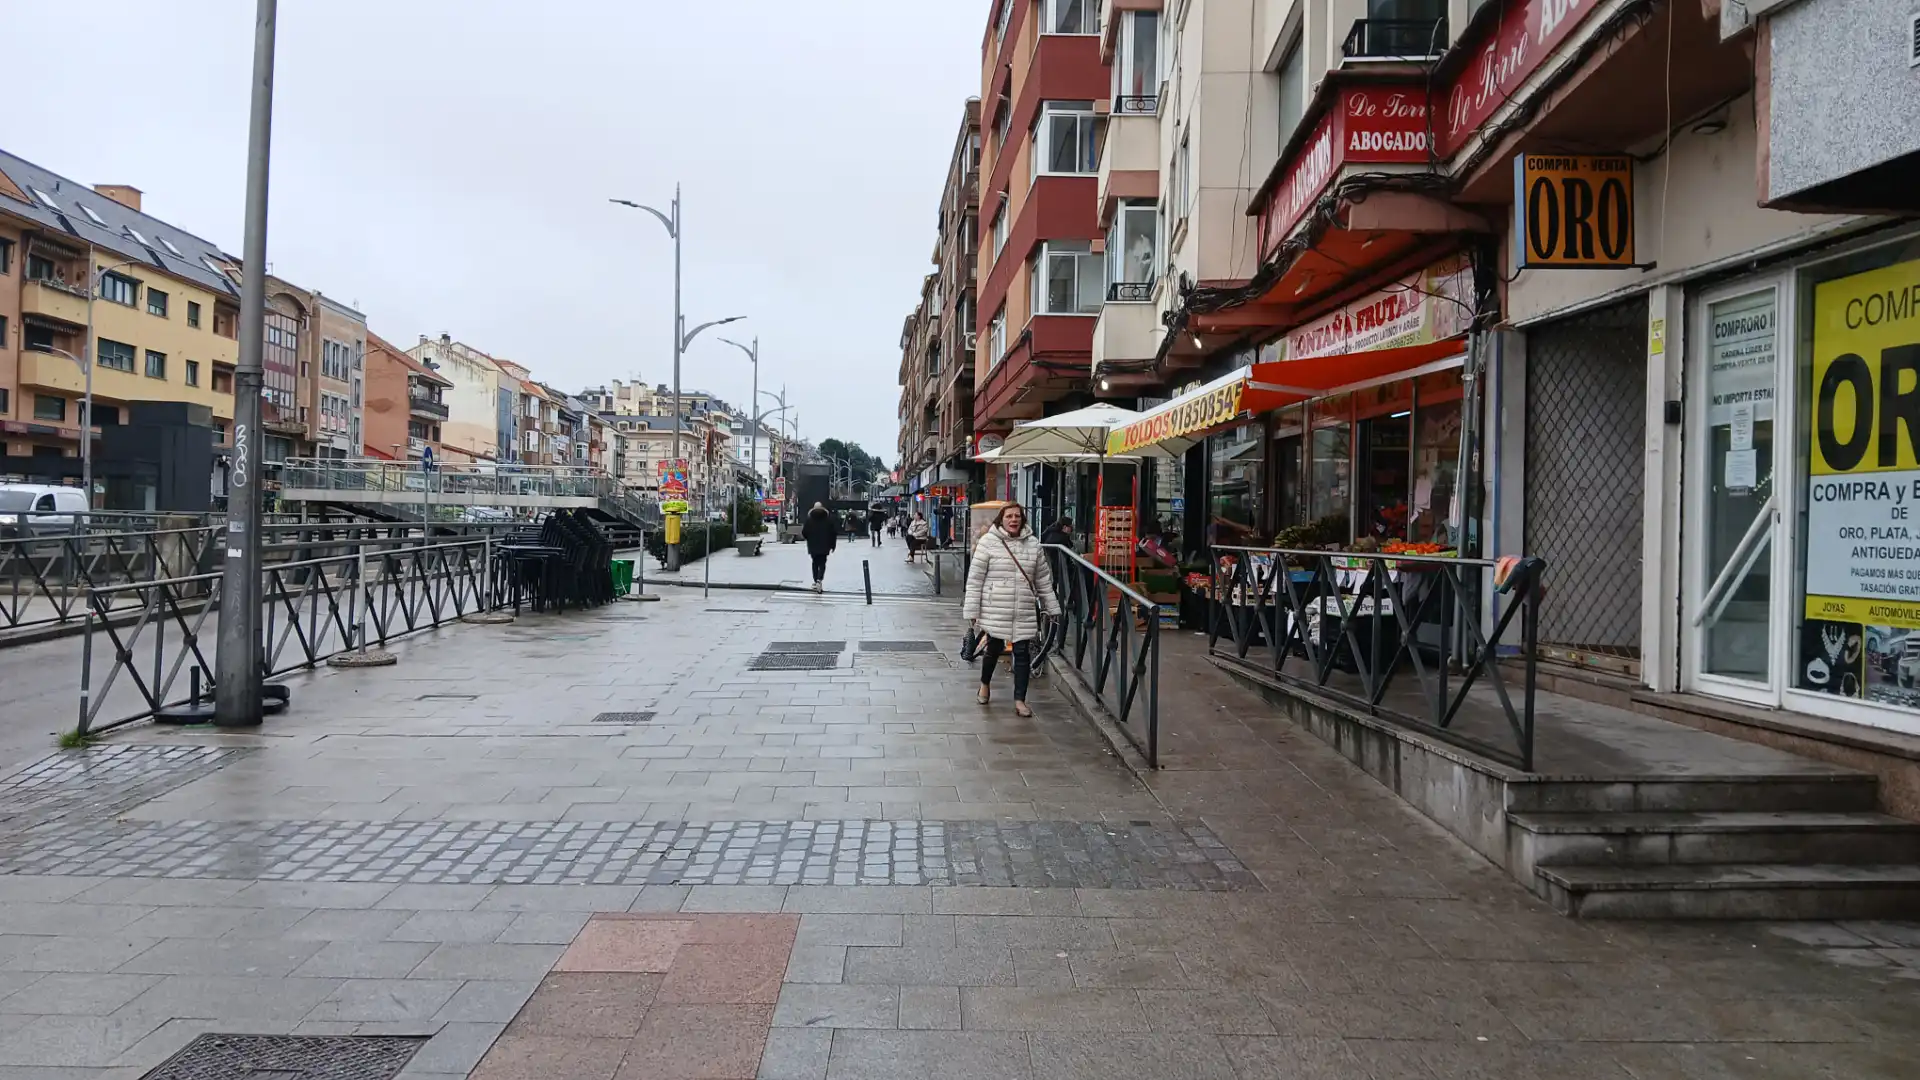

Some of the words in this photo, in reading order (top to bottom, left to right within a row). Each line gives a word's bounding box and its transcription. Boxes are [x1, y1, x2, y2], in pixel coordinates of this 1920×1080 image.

[1349, 93, 1376, 118] De
[1528, 158, 1579, 171] COMPRA
[1591, 159, 1628, 172] VENTA
[1528, 176, 1629, 260] ORO
[1356, 285, 1420, 335] FRUTAS
[1715, 314, 1767, 339] COMPRORO
[1723, 391, 1753, 405] IMPORTA
[1124, 411, 1172, 447] TOLDOS
[1814, 481, 1891, 502] COMPRA
[1896, 484, 1907, 505] y
[1891, 507, 1908, 520] DE
[1839, 526, 1867, 540] ORO,
[1871, 527, 1912, 541] PLATA,
[1851, 567, 1886, 579] PAGAMOS
[1822, 602, 1846, 614] JOYAS
